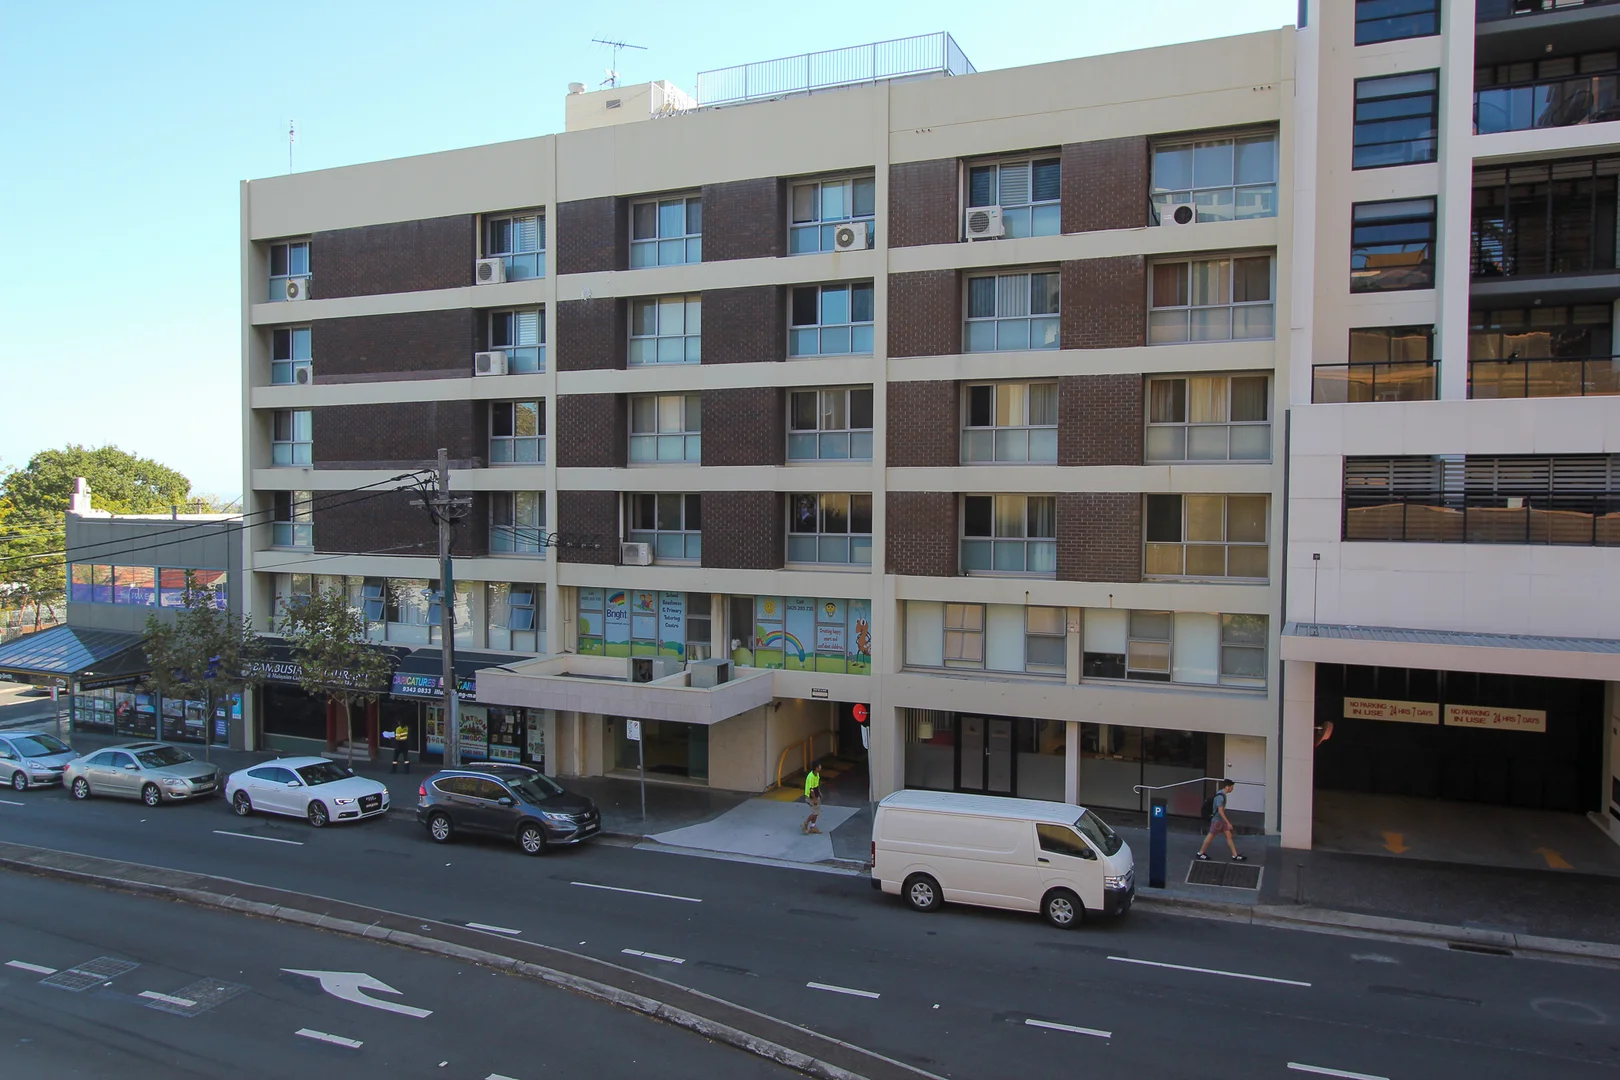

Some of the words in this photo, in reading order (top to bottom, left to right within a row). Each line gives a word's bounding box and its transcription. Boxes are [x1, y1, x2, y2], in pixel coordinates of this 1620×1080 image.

[606, 609, 627, 620] Bright
[393, 676, 436, 688] CARICATURES
[1359, 702, 1387, 710] PARKING
[1389, 705, 1397, 716] 24
[1412, 706, 1416, 717] 7
[1460, 709, 1490, 717] PARKING
[1464, 716, 1487, 724] USE
[1493, 712, 1501, 724] 24
[1516, 714, 1521, 725] 7
[1522, 716, 1540, 724] DAYS
[1154, 807, 1162, 816] P
